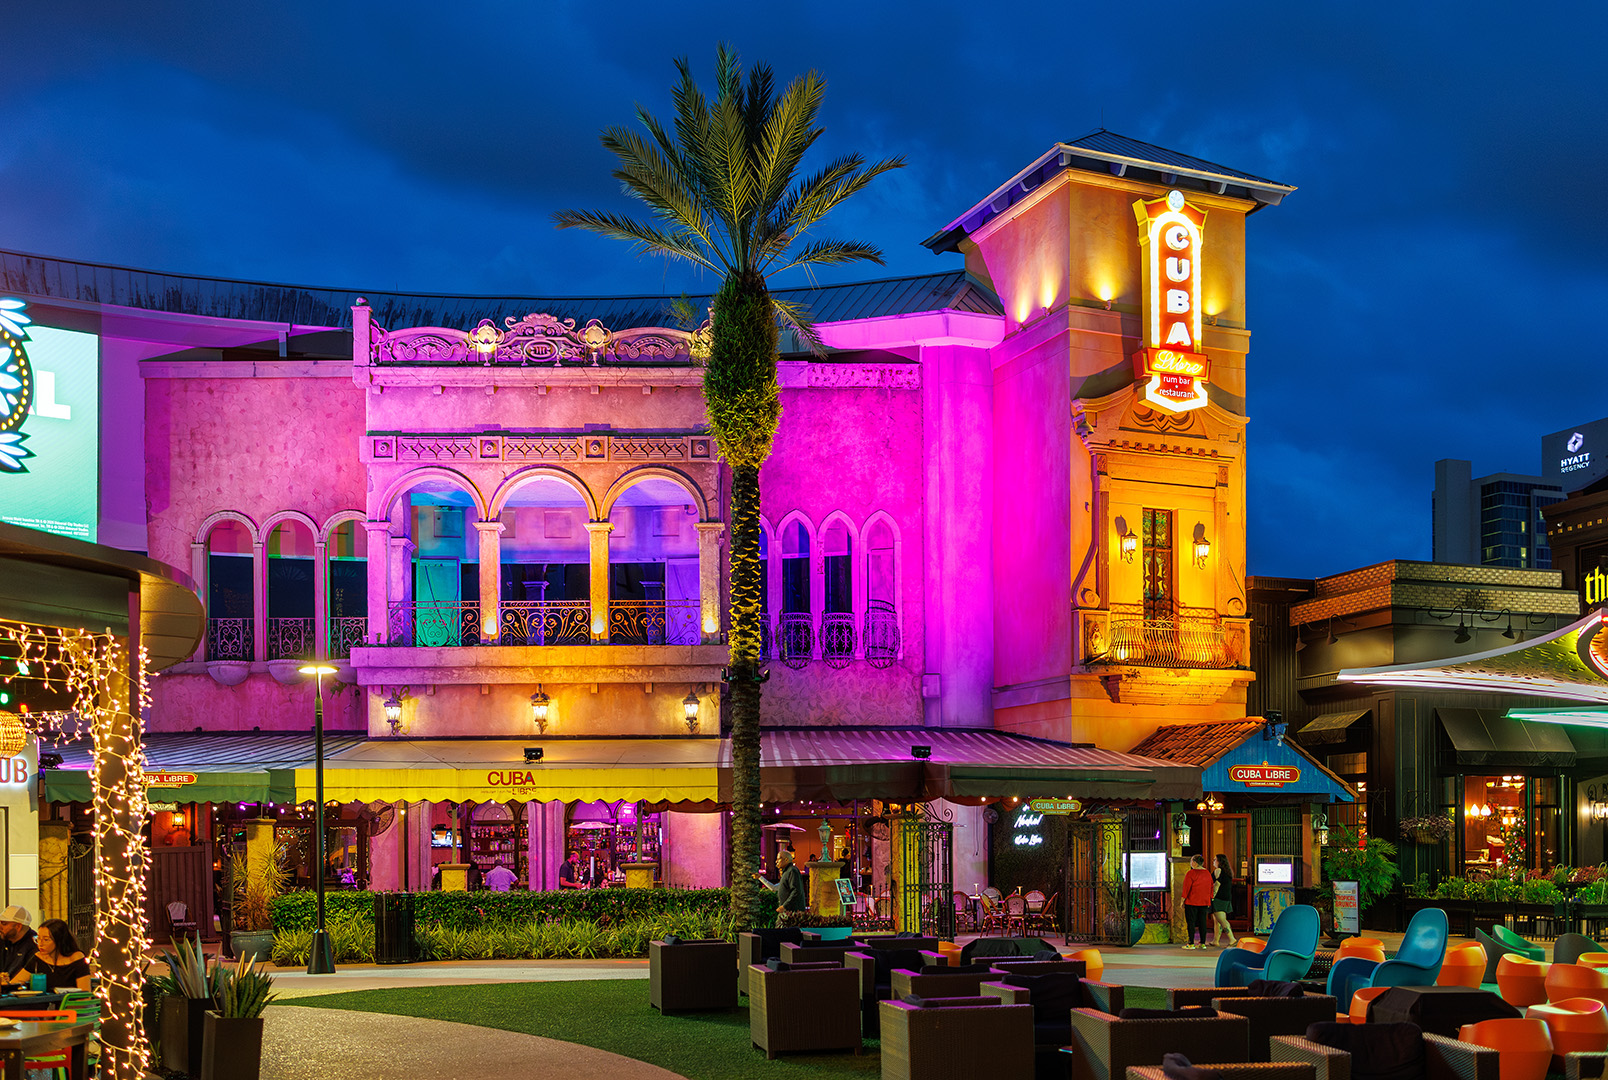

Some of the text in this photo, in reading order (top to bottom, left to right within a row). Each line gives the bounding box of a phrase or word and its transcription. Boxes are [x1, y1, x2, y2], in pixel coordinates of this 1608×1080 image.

[1165, 225, 1192, 347] CUBA
[1154, 350, 1204, 374] Libre
[1163, 376, 1191, 385] rum bar
[1160, 388, 1195, 399] restaurant
[1561, 452, 1591, 467] HYATT
[1561, 461, 1590, 474] REGENCY
[1585, 565, 1608, 605] th
[487, 771, 536, 786] CUBA
[1237, 770, 1261, 778] CUBA
